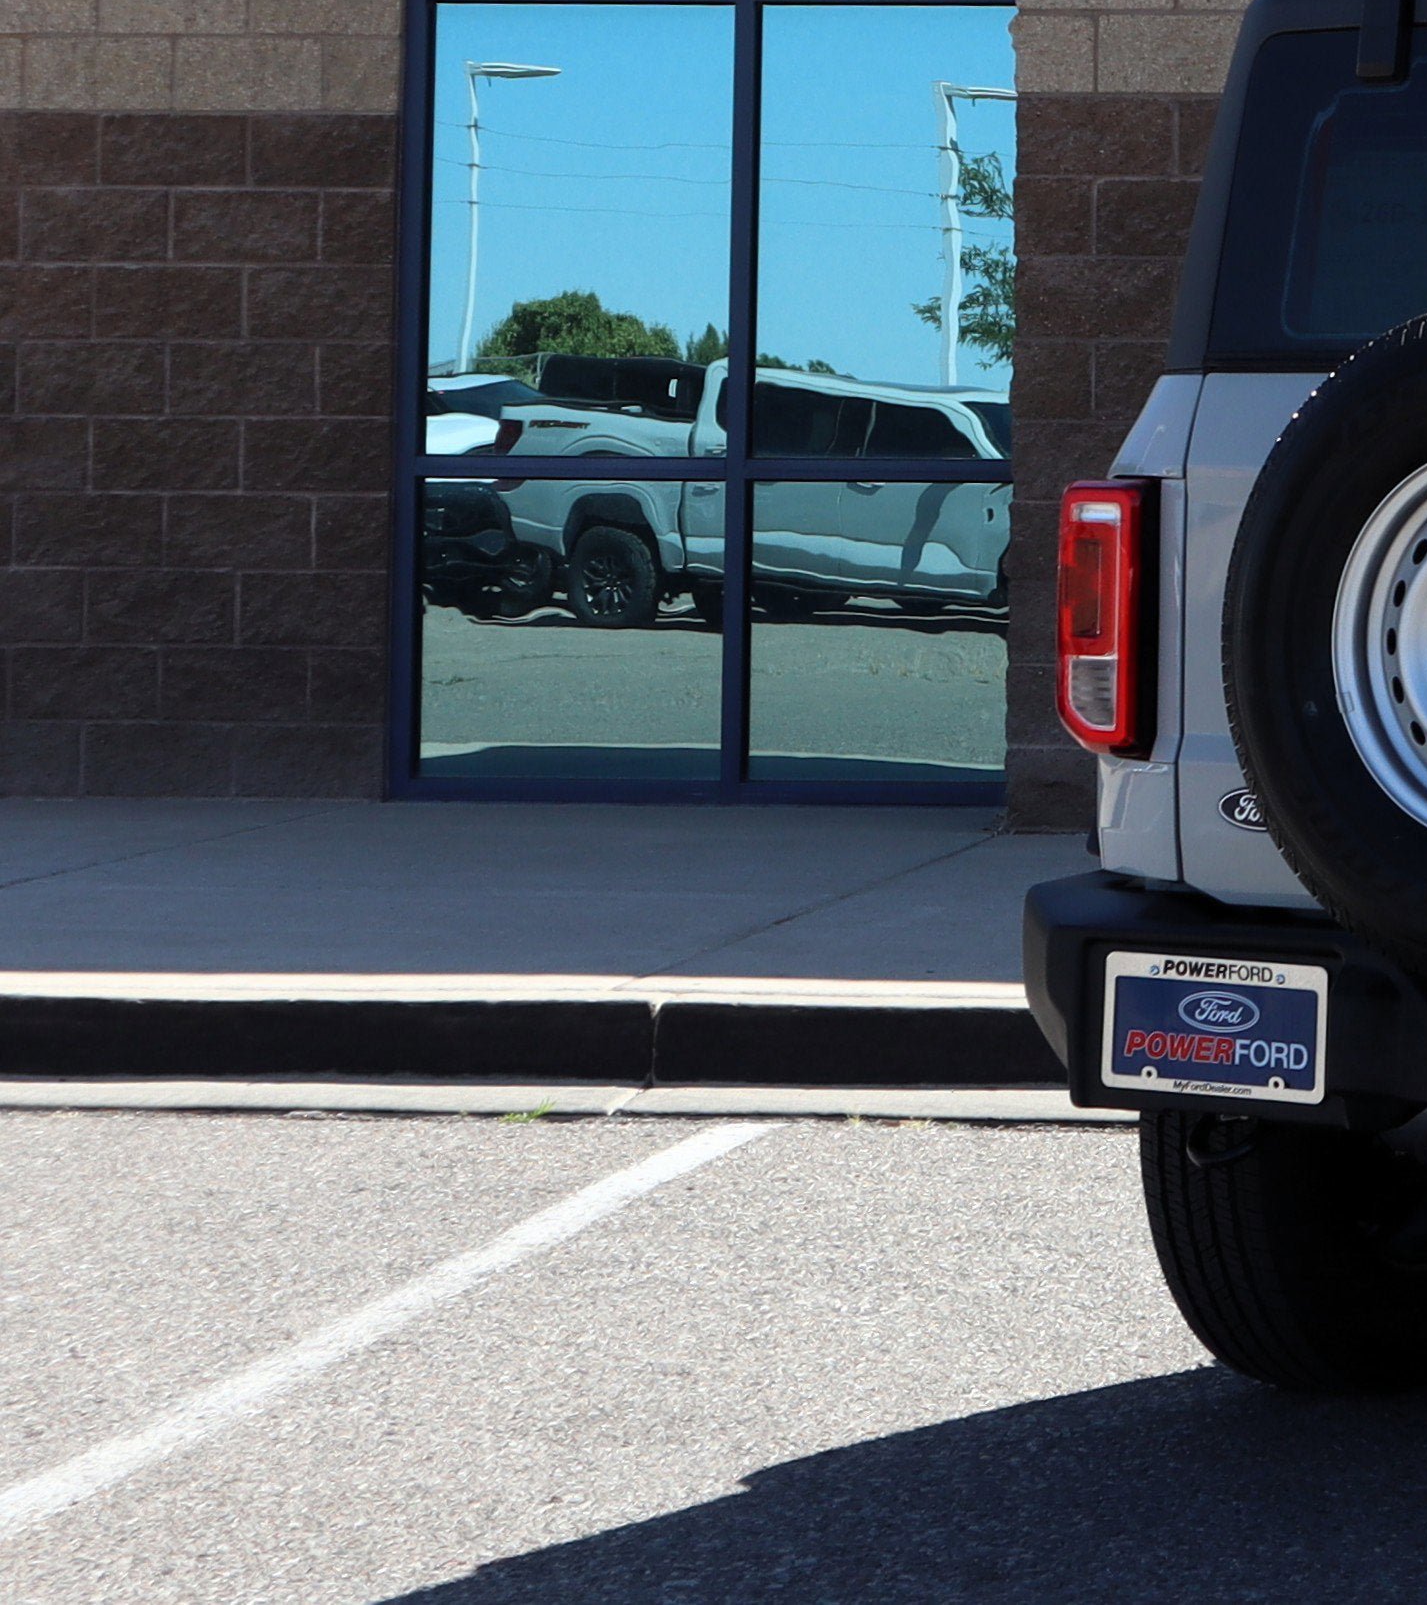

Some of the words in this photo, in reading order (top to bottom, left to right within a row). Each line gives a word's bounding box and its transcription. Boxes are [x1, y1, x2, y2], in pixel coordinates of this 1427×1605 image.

[1234, 794, 1264, 823] Fo
[1194, 997, 1244, 1025] Ford
[1172, 1079, 1252, 1095] MyFordDealer.com
